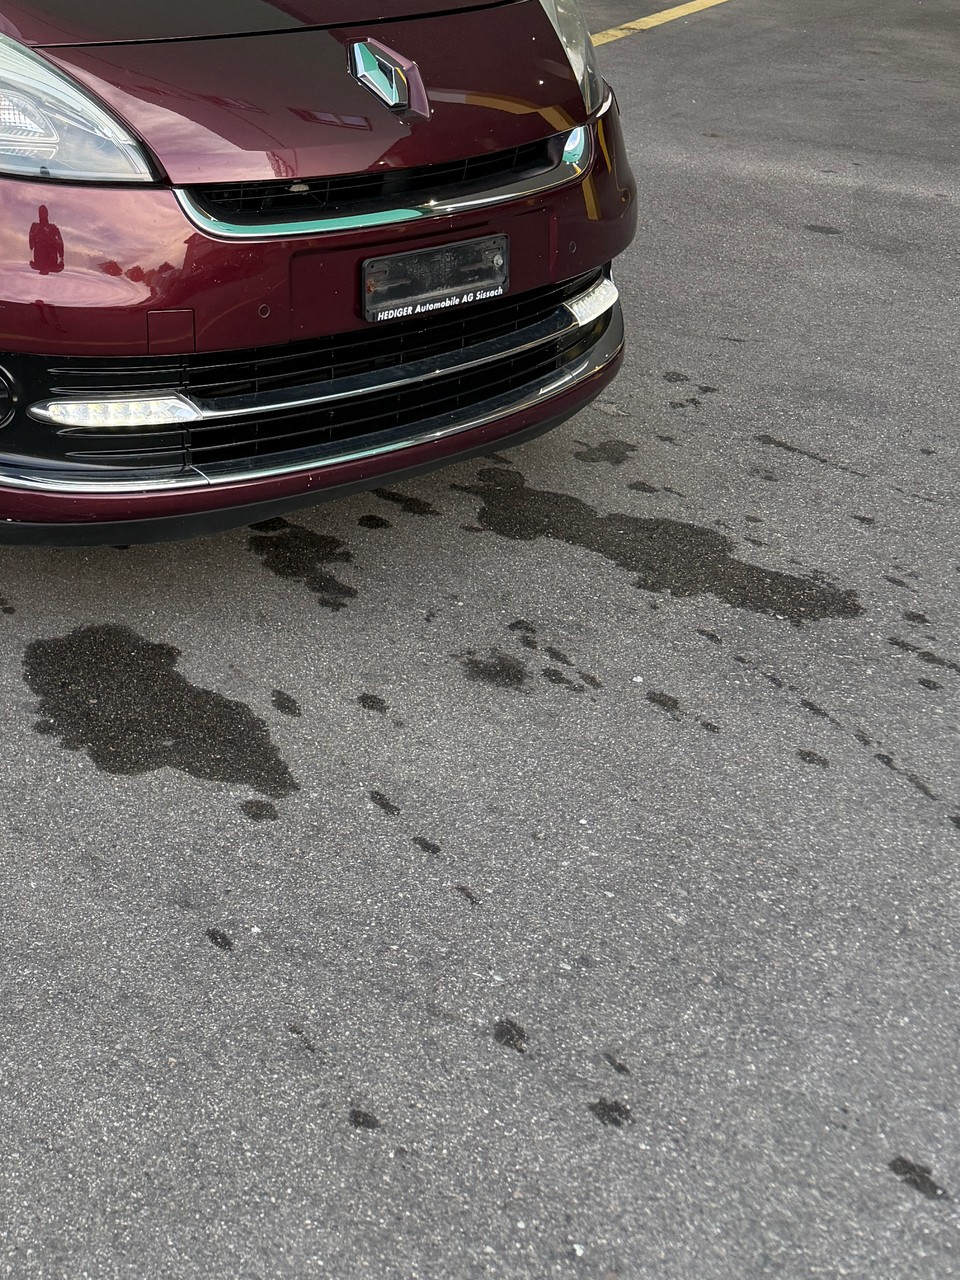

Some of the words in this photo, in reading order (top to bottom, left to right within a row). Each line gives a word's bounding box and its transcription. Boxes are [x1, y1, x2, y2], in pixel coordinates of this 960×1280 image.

[377, 305, 413, 322] HEDIGER
[414, 297, 460, 313] Automobile
[461, 292, 474, 303] AG
[475, 286, 503, 301] Sissach
